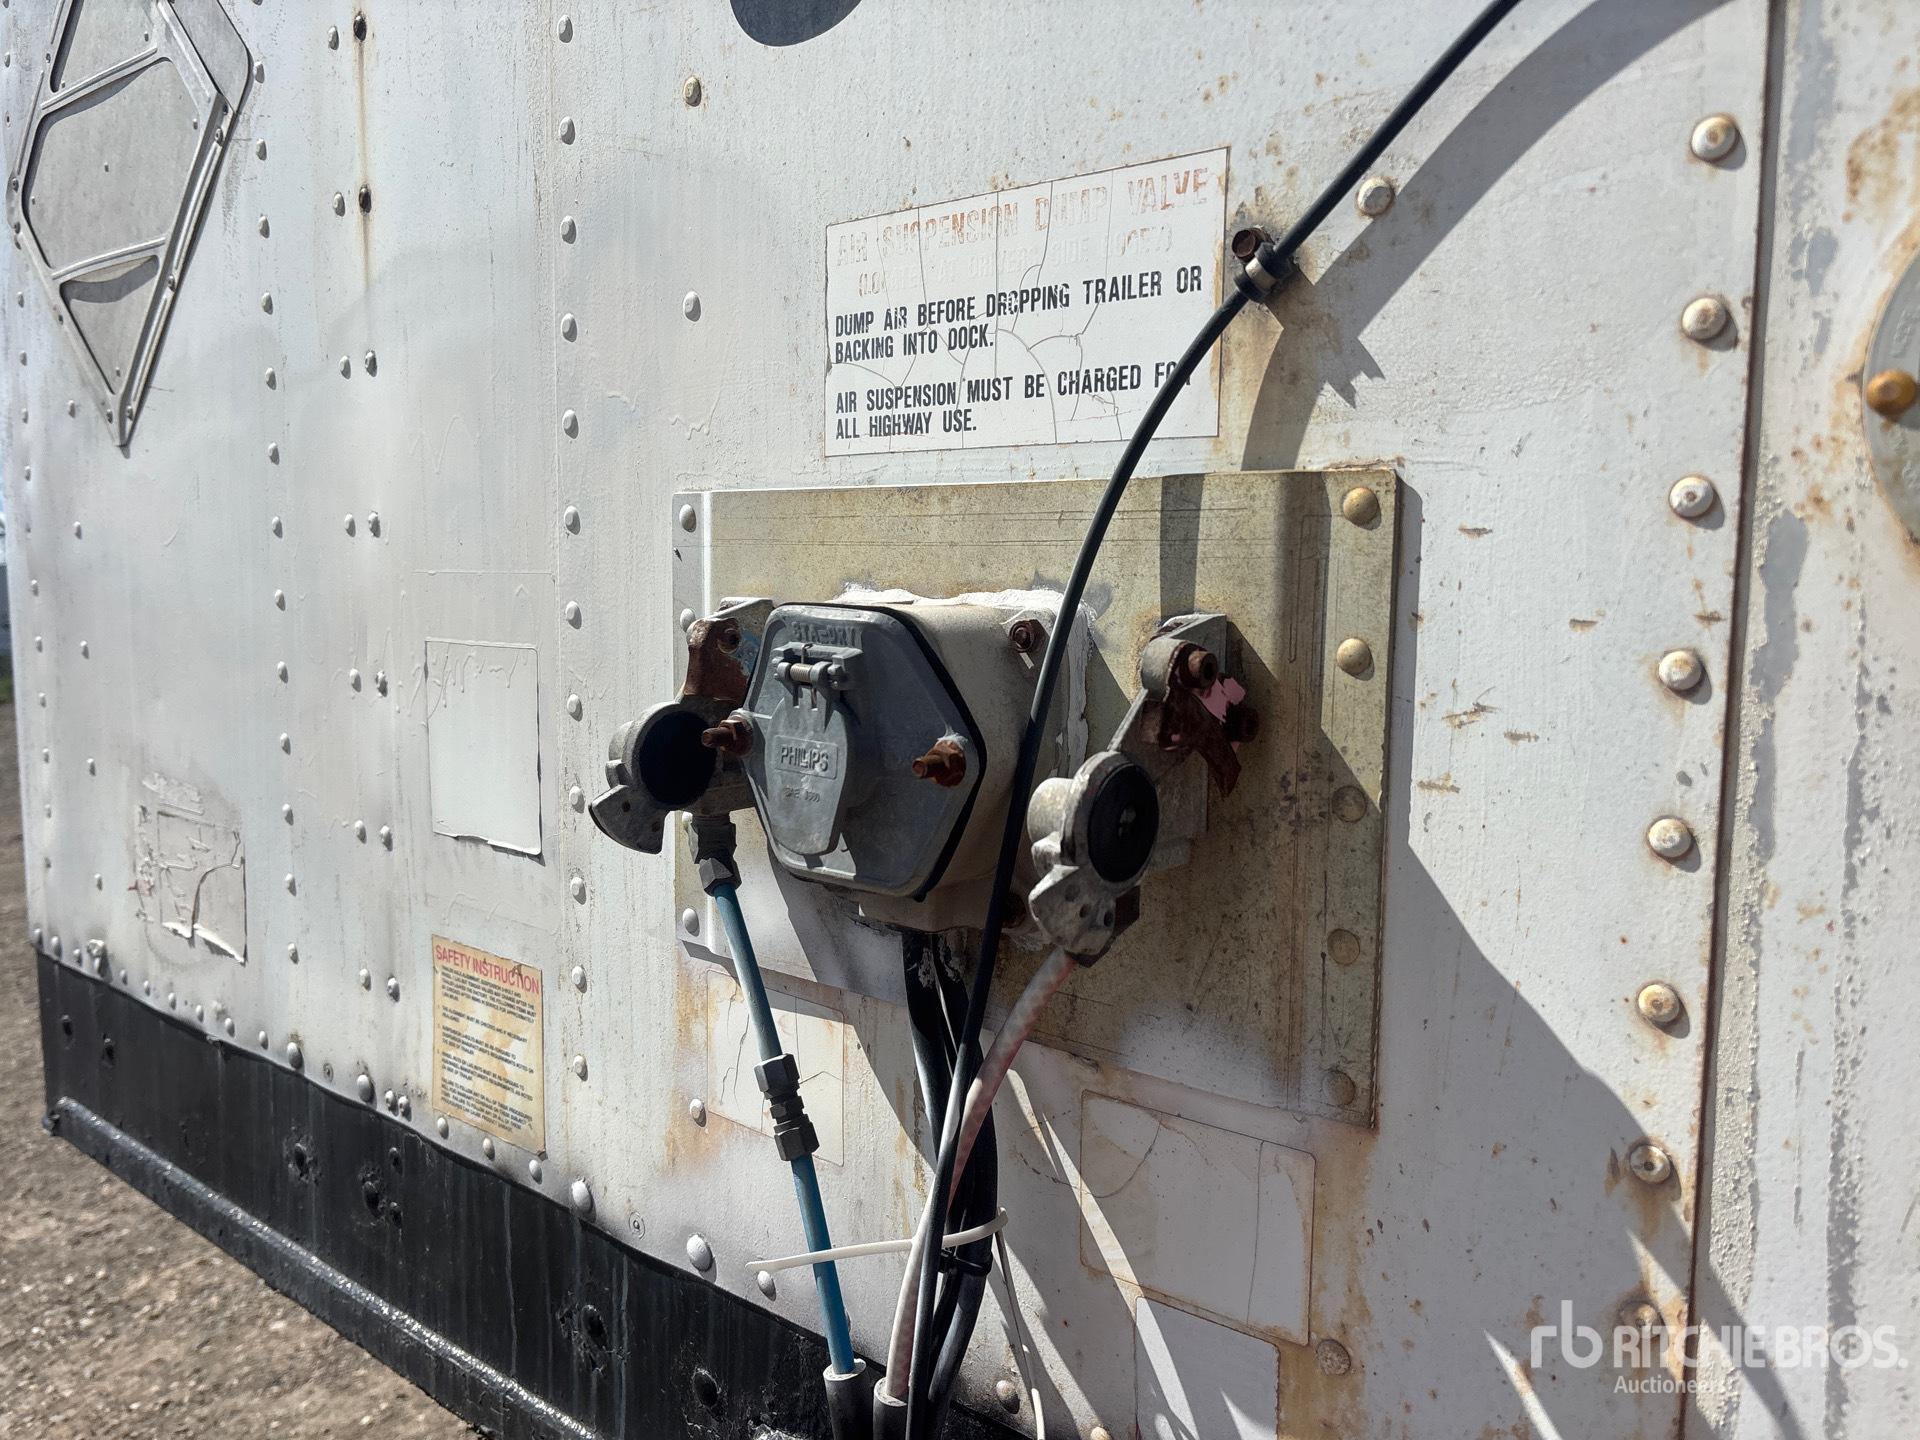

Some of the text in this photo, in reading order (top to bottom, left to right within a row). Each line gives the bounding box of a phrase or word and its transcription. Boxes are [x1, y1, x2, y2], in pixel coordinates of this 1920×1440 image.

[837, 232, 868, 266] AIR
[882, 202, 1018, 258] SUSPENSION
[1127, 167, 1208, 215] VALVE
[835, 265, 1202, 337] DUMP AIR BEFORE DROPPING TRAILER OR
[835, 323, 994, 364] BACKING INTO DOCK.
[836, 361, 1191, 414] AIR SUSPENSION MUST BE CHARGED FO
[836, 409, 977, 440] ALL HIGHWAY USE.
[435, 944, 470, 970] SAFETY
[472, 957, 540, 995] INSTRUCTION
